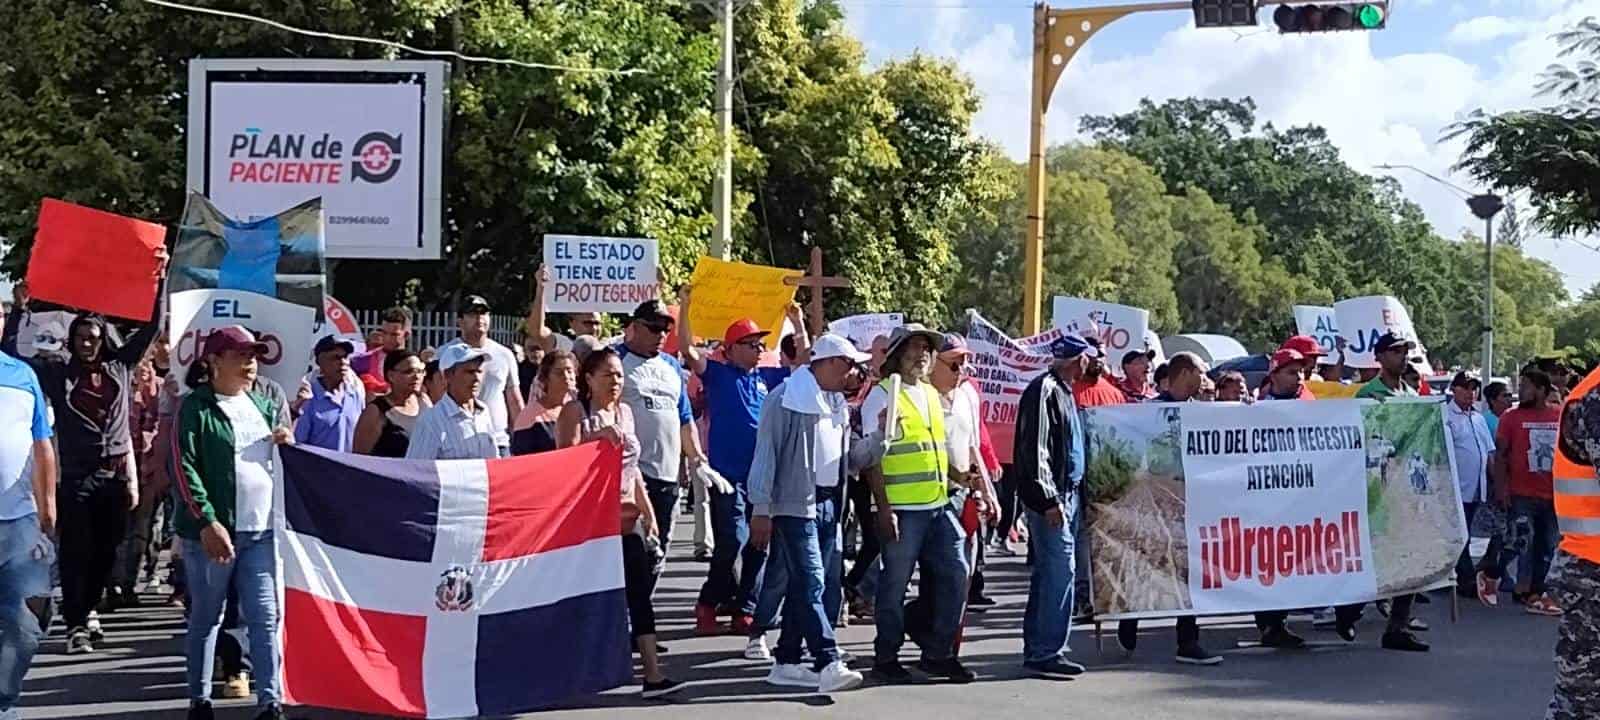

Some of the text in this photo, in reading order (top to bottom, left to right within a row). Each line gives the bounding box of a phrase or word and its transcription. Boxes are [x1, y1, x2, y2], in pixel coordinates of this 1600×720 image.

[230, 133, 343, 159] PLAN de
[229, 161, 343, 184] PACIENTE
[555, 242, 645, 260] EL ESTADO
[554, 265, 636, 280] TIENE QUE
[213, 300, 251, 319] EL
[1094, 310, 1113, 326] EL
[1315, 315, 1339, 333] AL
[1186, 425, 1362, 455] ALTO DEL CEDRO NECESITA
[1247, 459, 1314, 490] ATENCIÓN
[1200, 511, 1362, 589] ¡¡Urgente!!
